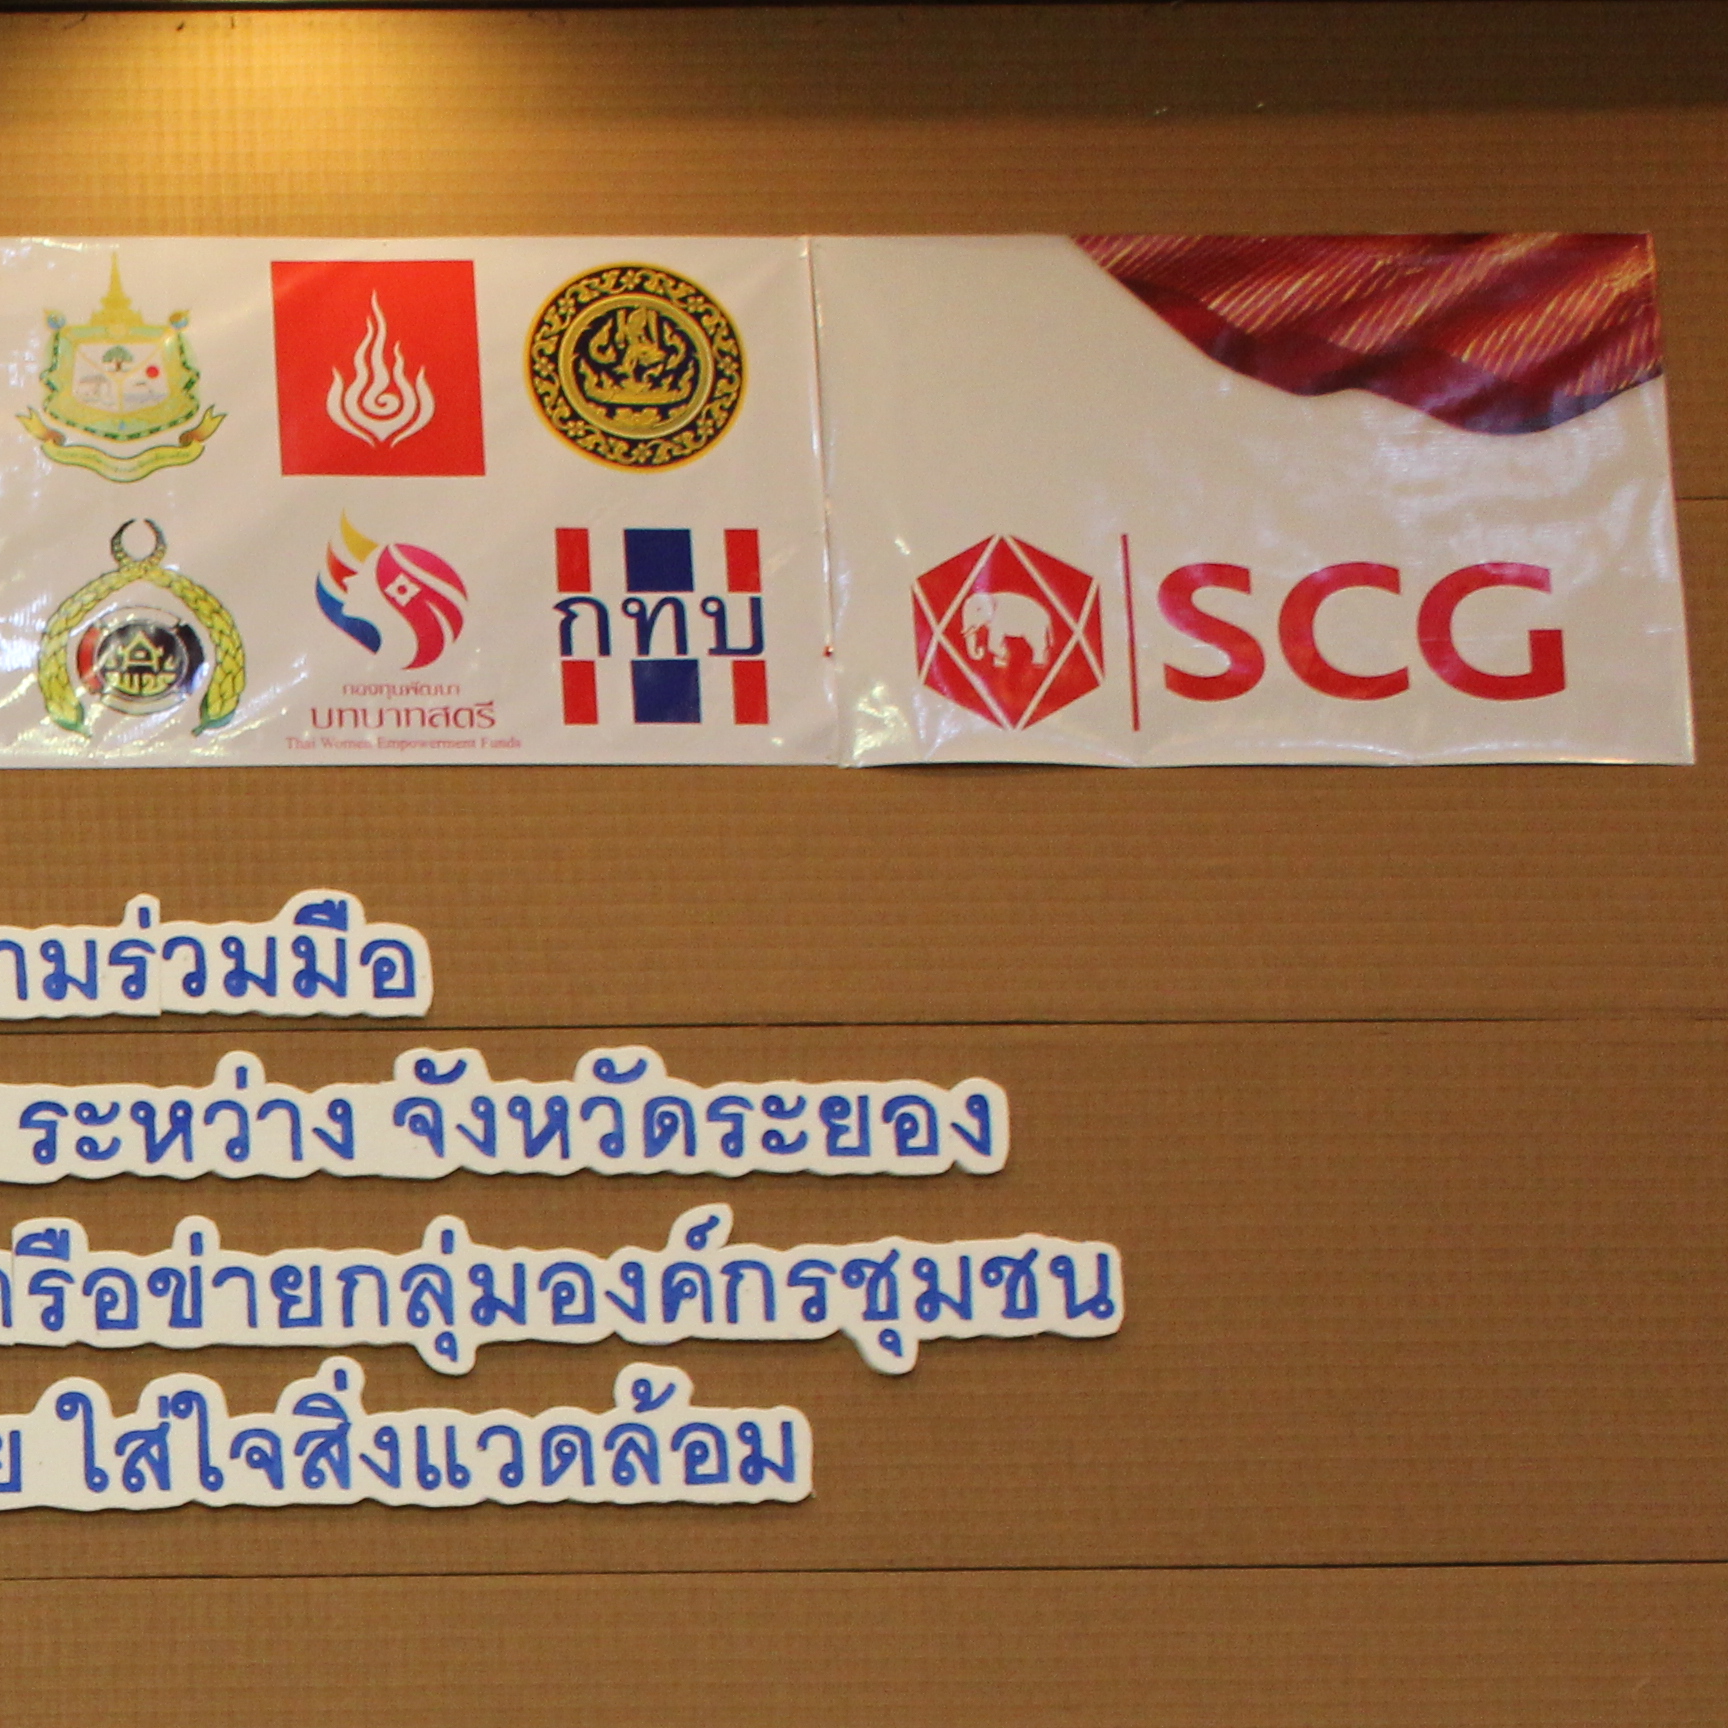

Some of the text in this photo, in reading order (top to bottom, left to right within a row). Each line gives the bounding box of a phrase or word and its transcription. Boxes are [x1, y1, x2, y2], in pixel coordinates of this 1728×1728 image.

[552, 596, 764, 657] กทบ
[1157, 561, 1567, 702] SCG
[310, 700, 496, 730] บทบาทสตรี
[342, 681, 461, 700] กองทุนพัฒนา
[286, 737, 316, 750] Thai
[376, 737, 476, 752] Empowerment
[21, 1065, 355, 1164] ระหว่าง
[395, 1057, 993, 1158] จังหวัดระยอง
[57, 1368, 796, 1492] ใส่ใจสิ่งแวดล้อม
